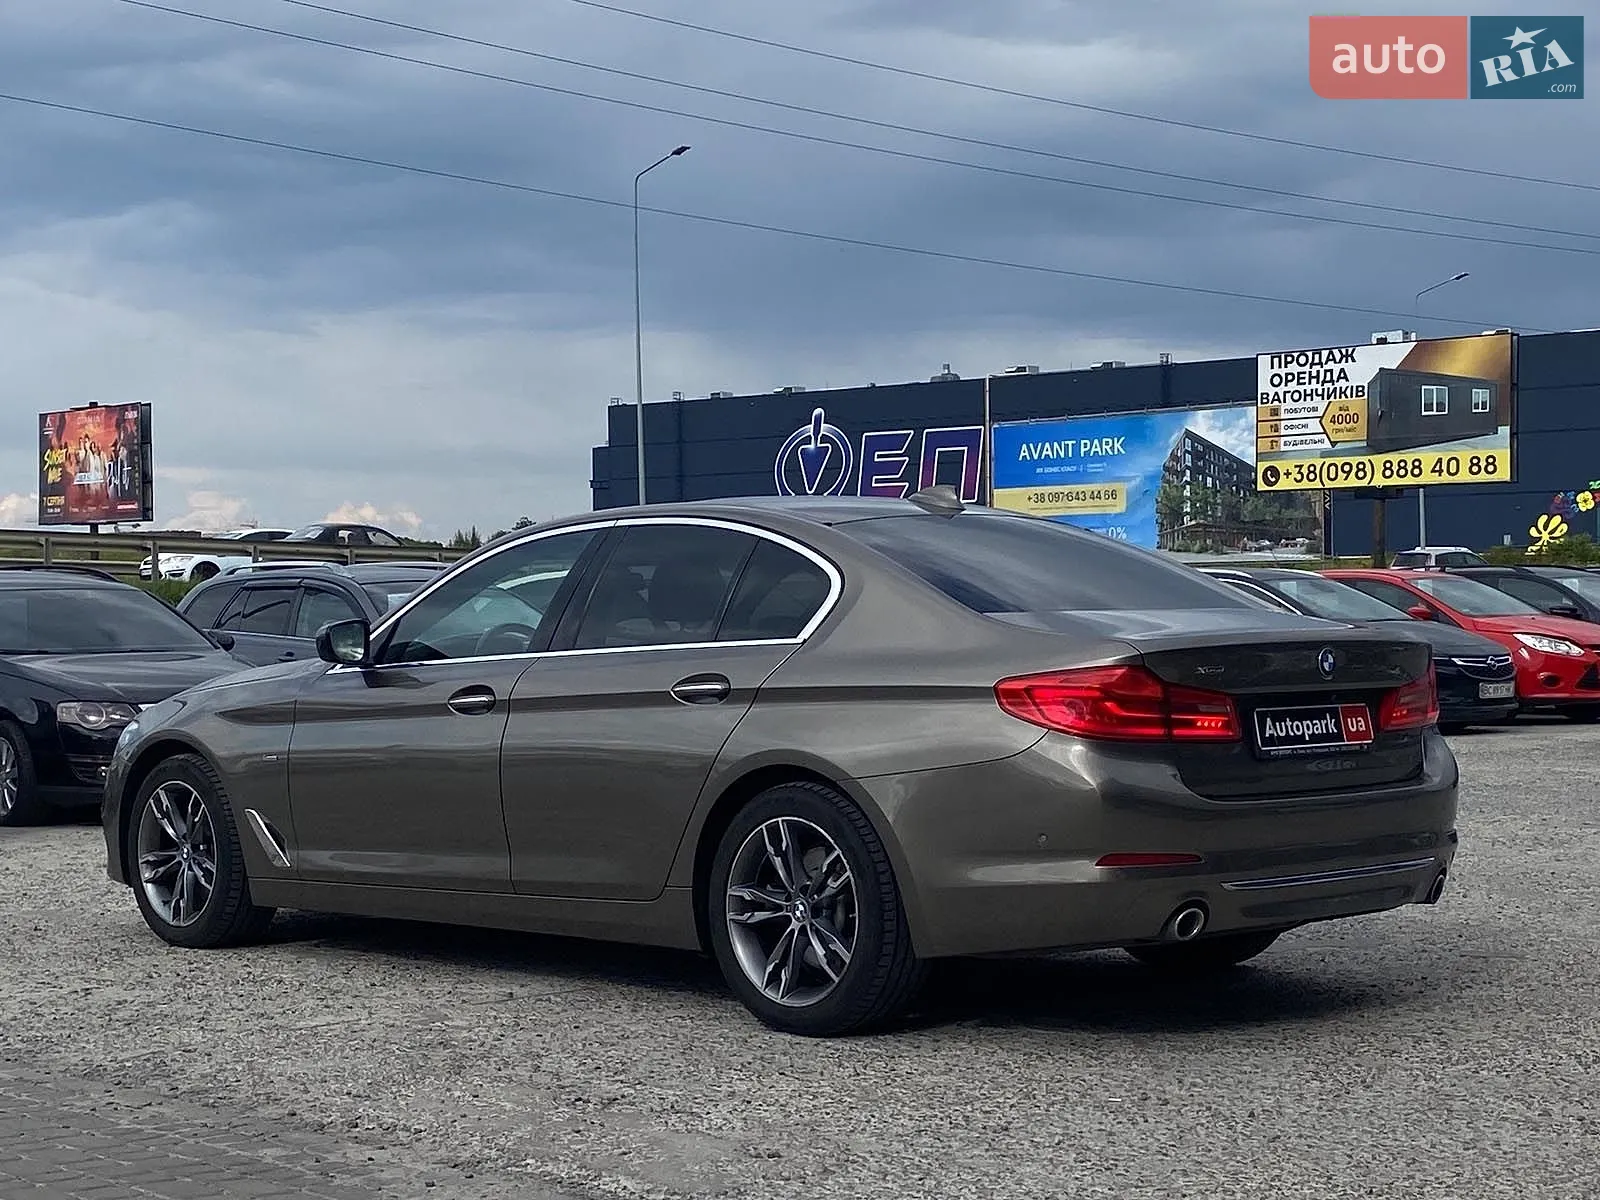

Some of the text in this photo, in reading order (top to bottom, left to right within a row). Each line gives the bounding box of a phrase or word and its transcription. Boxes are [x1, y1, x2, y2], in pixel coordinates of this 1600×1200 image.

[1270, 347, 1357, 370] ПРОДАЖ
[1269, 367, 1350, 388] ОРЕНДА
[1260, 384, 1366, 405] ВАГОНЧИКІВ
[1283, 423, 1309, 431] ОФІСНІ
[1329, 412, 1360, 425] 4000
[1019, 436, 1126, 461] AVANT PARK
[1283, 454, 1498, 487] +38(098) 888 40 88
[1027, 488, 1118, 504] +38 097 643 44 66
[1264, 712, 1366, 741] Autopark ua
